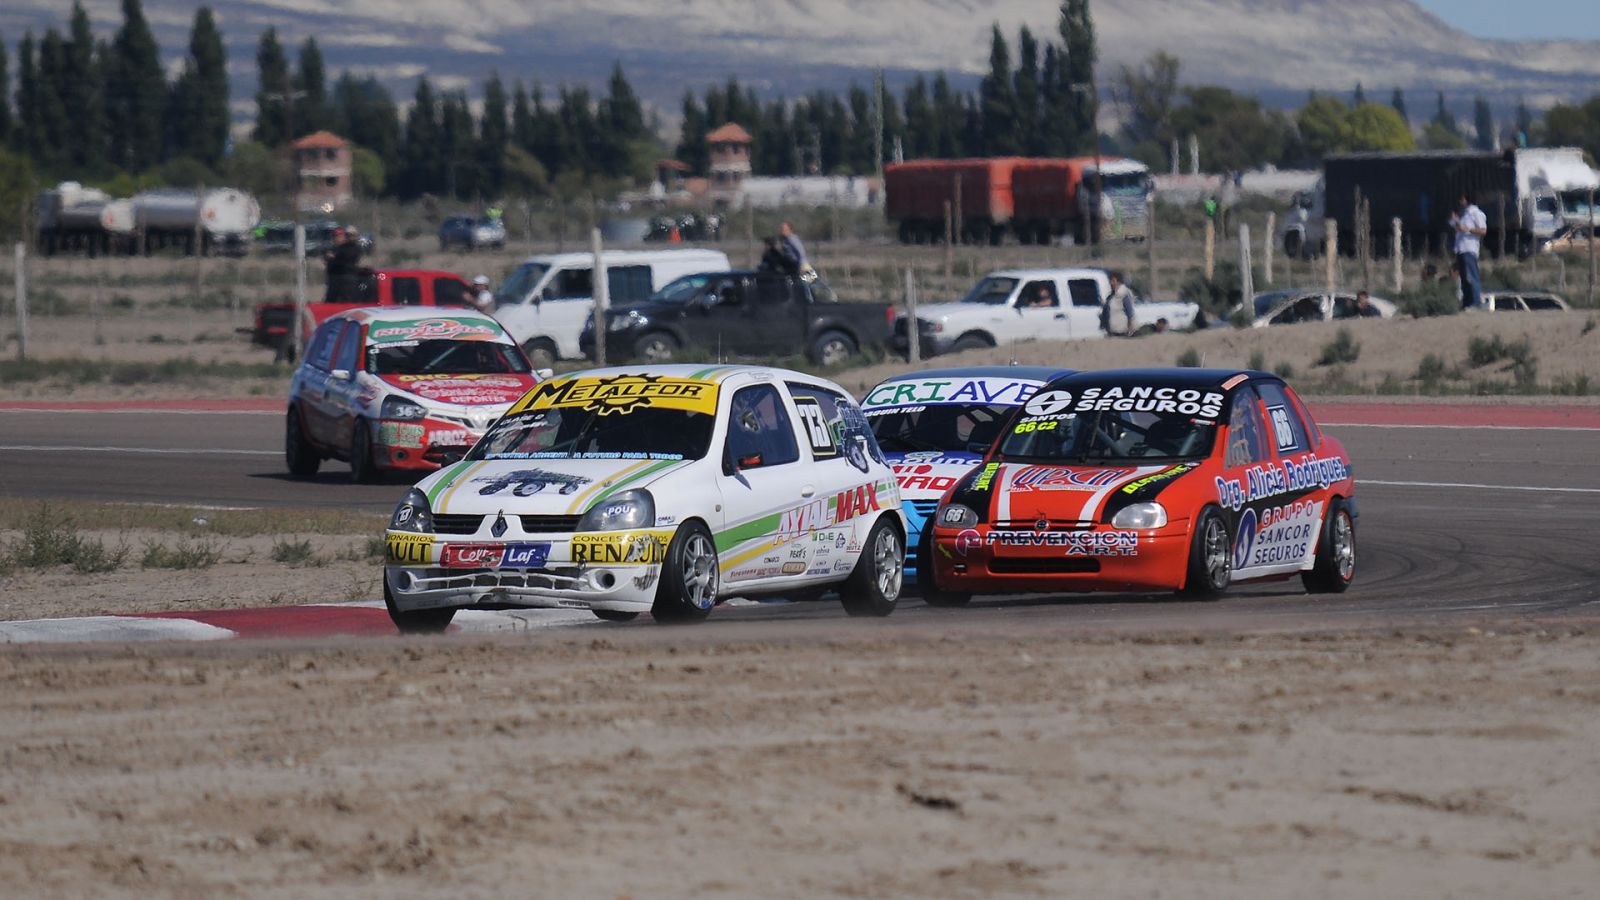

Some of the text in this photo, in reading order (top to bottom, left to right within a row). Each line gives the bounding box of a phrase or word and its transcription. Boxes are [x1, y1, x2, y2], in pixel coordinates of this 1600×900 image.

[524, 379, 704, 410] METALFOR
[1080, 386, 1225, 406] SANCOR
[1019, 413, 1078, 423] SANTOS
[1074, 398, 1221, 418] SEGUROS
[1014, 421, 1036, 434] 66
[1271, 410, 1294, 448] 66
[1246, 463, 1286, 501] Alicia
[1284, 453, 1348, 489] Rodriguez
[946, 509, 964, 522] 66
[1262, 500, 1314, 527] GRUPO
[986, 530, 1138, 546] PREVENCION
[1257, 524, 1310, 545] SANCOR
[1254, 543, 1307, 564] SEGUROS
